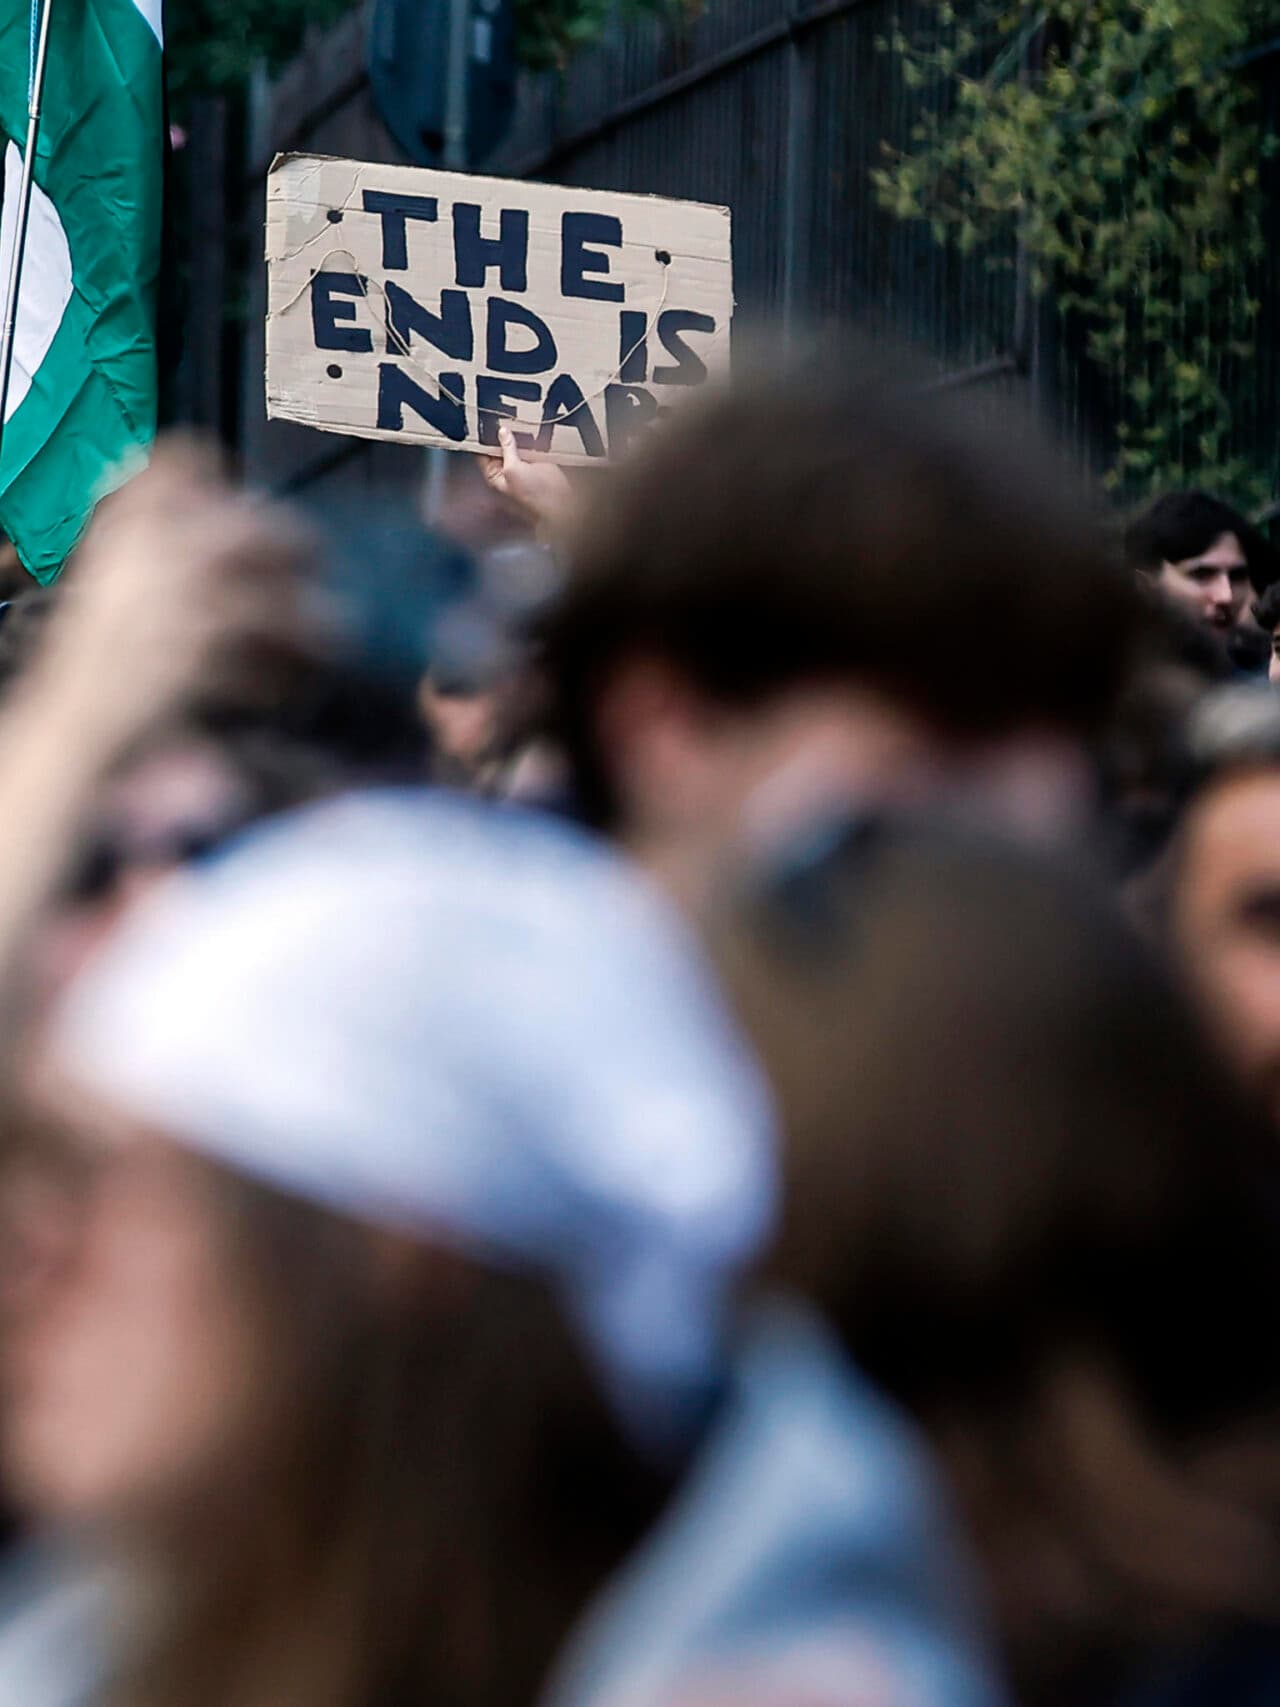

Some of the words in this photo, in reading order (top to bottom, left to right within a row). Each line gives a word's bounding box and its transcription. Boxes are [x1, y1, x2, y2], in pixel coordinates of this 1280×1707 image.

[363, 189, 625, 303] THE
[310, 270, 558, 375] END
[619, 309, 716, 386] IS
